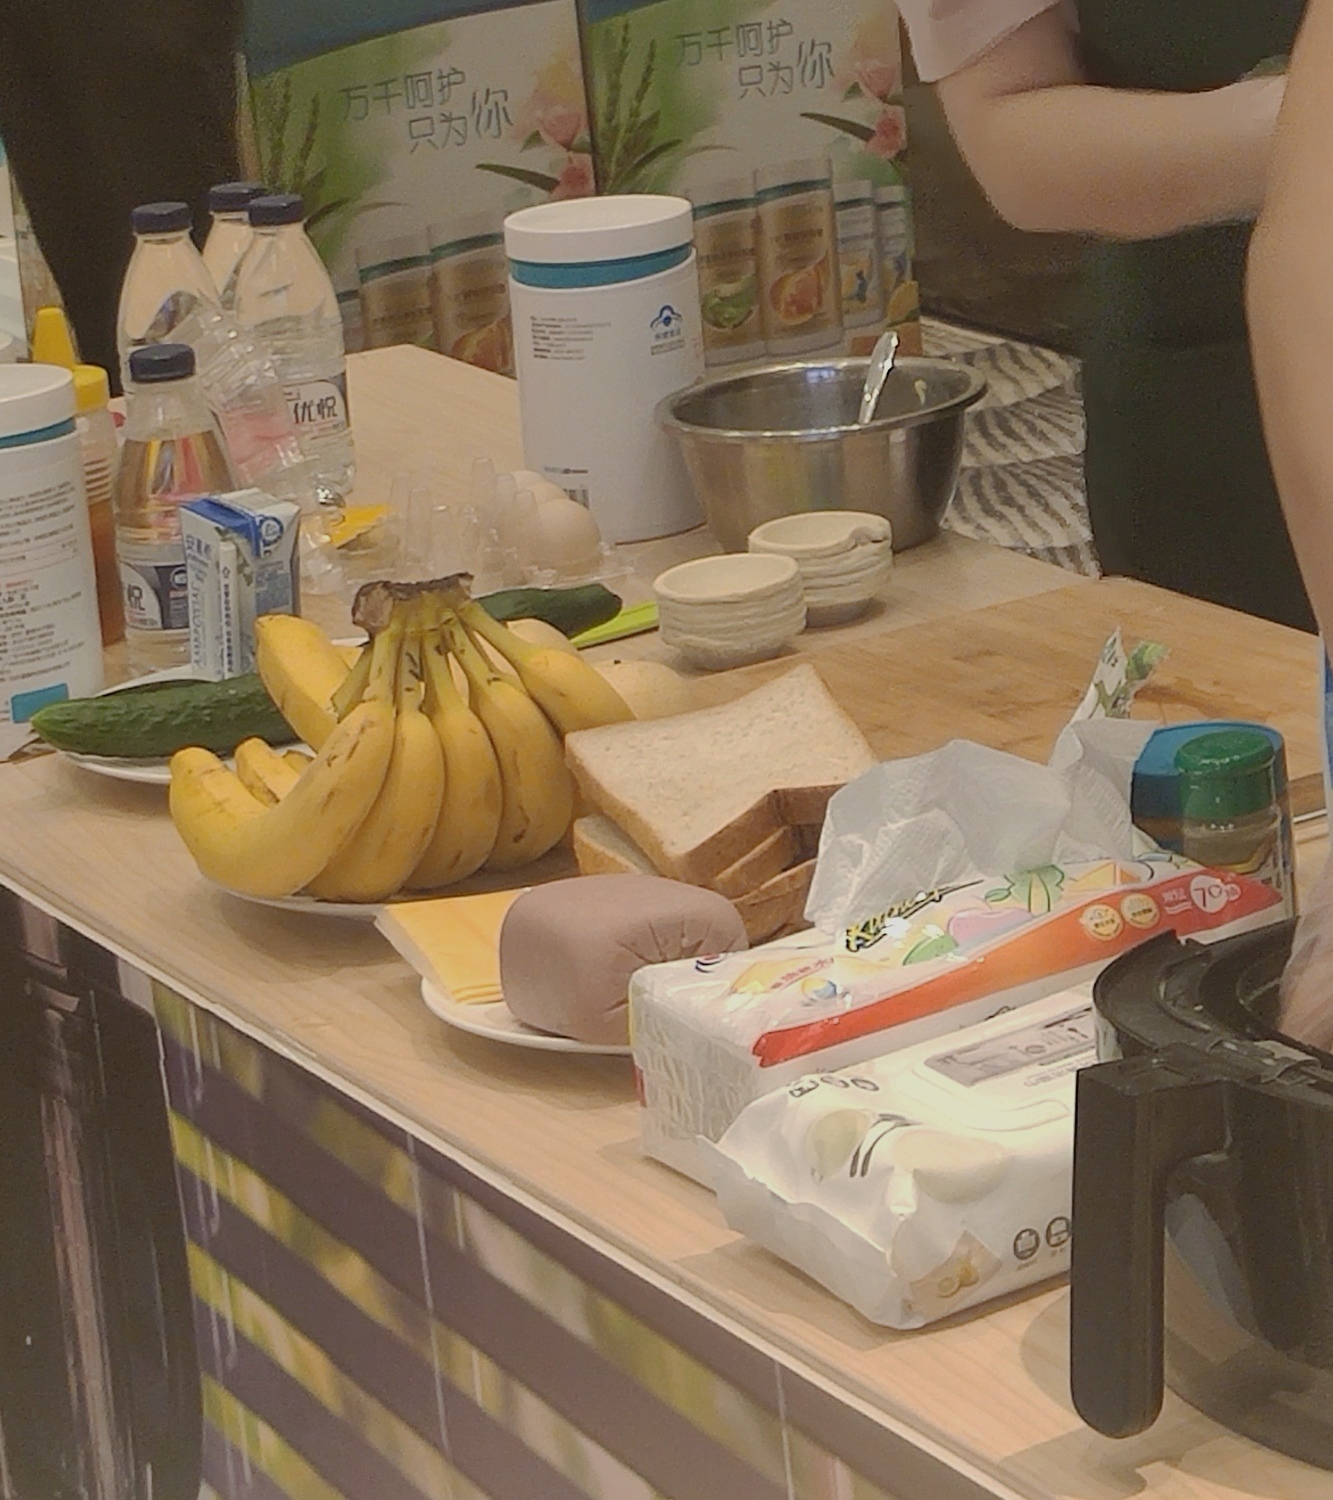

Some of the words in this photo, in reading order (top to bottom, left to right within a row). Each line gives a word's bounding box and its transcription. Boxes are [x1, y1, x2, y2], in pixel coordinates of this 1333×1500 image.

[674, 19, 793, 69] 万千呵护
[738, 39, 835, 99] 只为你
[340, 67, 466, 121] 万千呵护
[408, 87, 514, 154] 只为你
